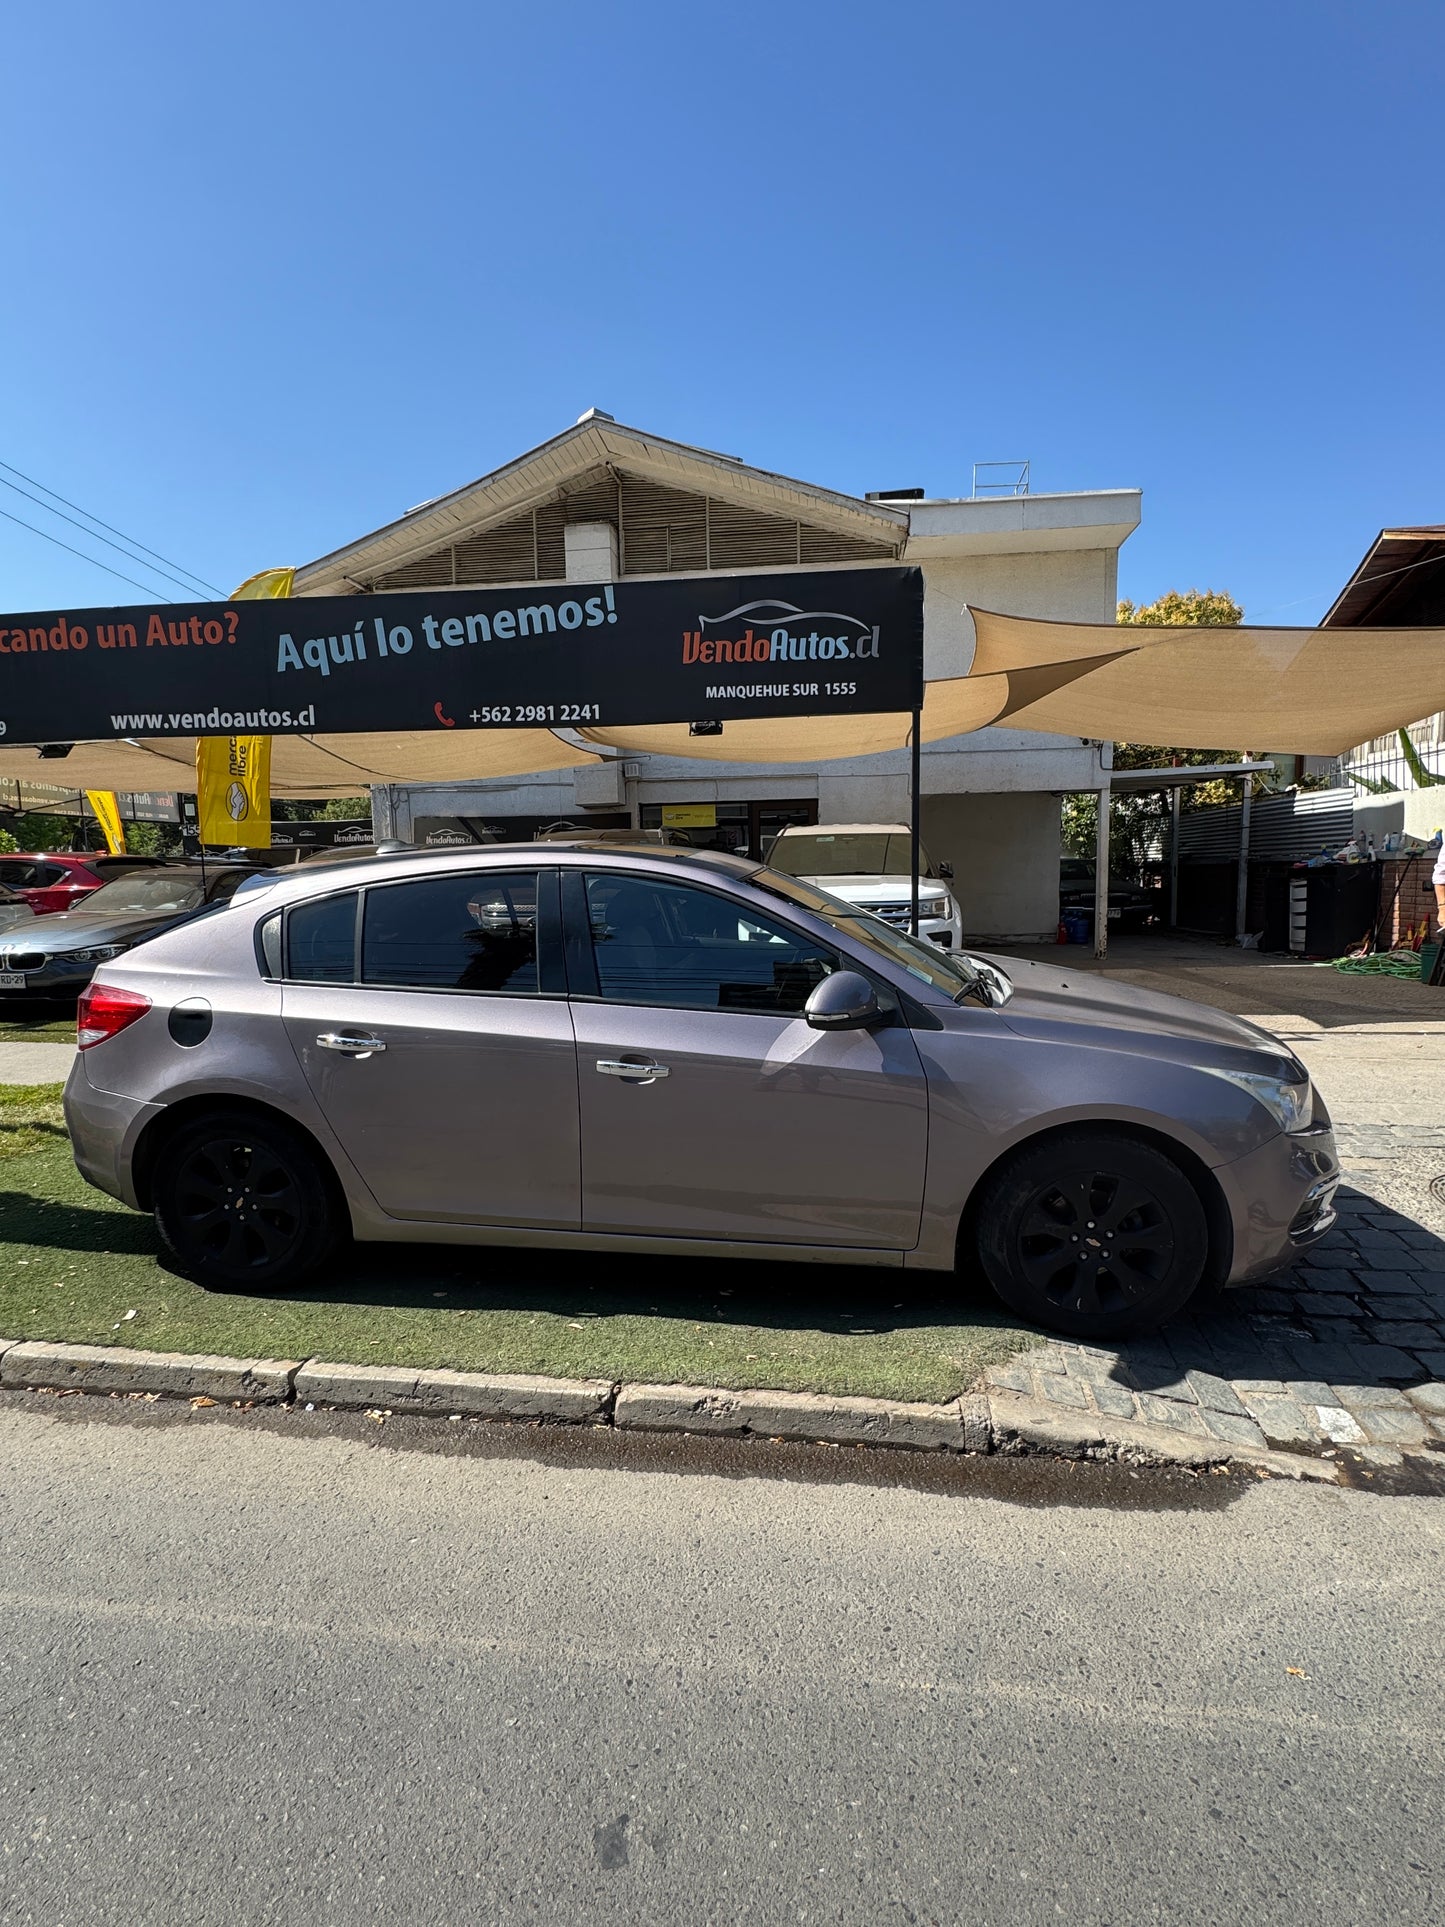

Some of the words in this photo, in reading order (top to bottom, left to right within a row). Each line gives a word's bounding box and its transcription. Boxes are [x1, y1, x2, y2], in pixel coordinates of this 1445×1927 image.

[0, 617, 89, 653] cando
[96, 623, 138, 648] un
[146, 611, 239, 647] Auto?
[277, 620, 367, 676] Aquí
[374, 617, 414, 657] lo
[421, 585, 618, 650] tenemos!
[682, 625, 881, 665] VendoAutos.cl
[705, 684, 790, 699] MANQUEHUE
[792, 683, 819, 696] SUR
[824, 682, 857, 695] 1555
[110, 704, 316, 730] www.vendoautos.cl
[469, 706, 512, 723] +562
[515, 705, 555, 722] 2981
[560, 704, 600, 721] 2241
[229, 735, 238, 776] merc
[237, 745, 247, 777] libre
